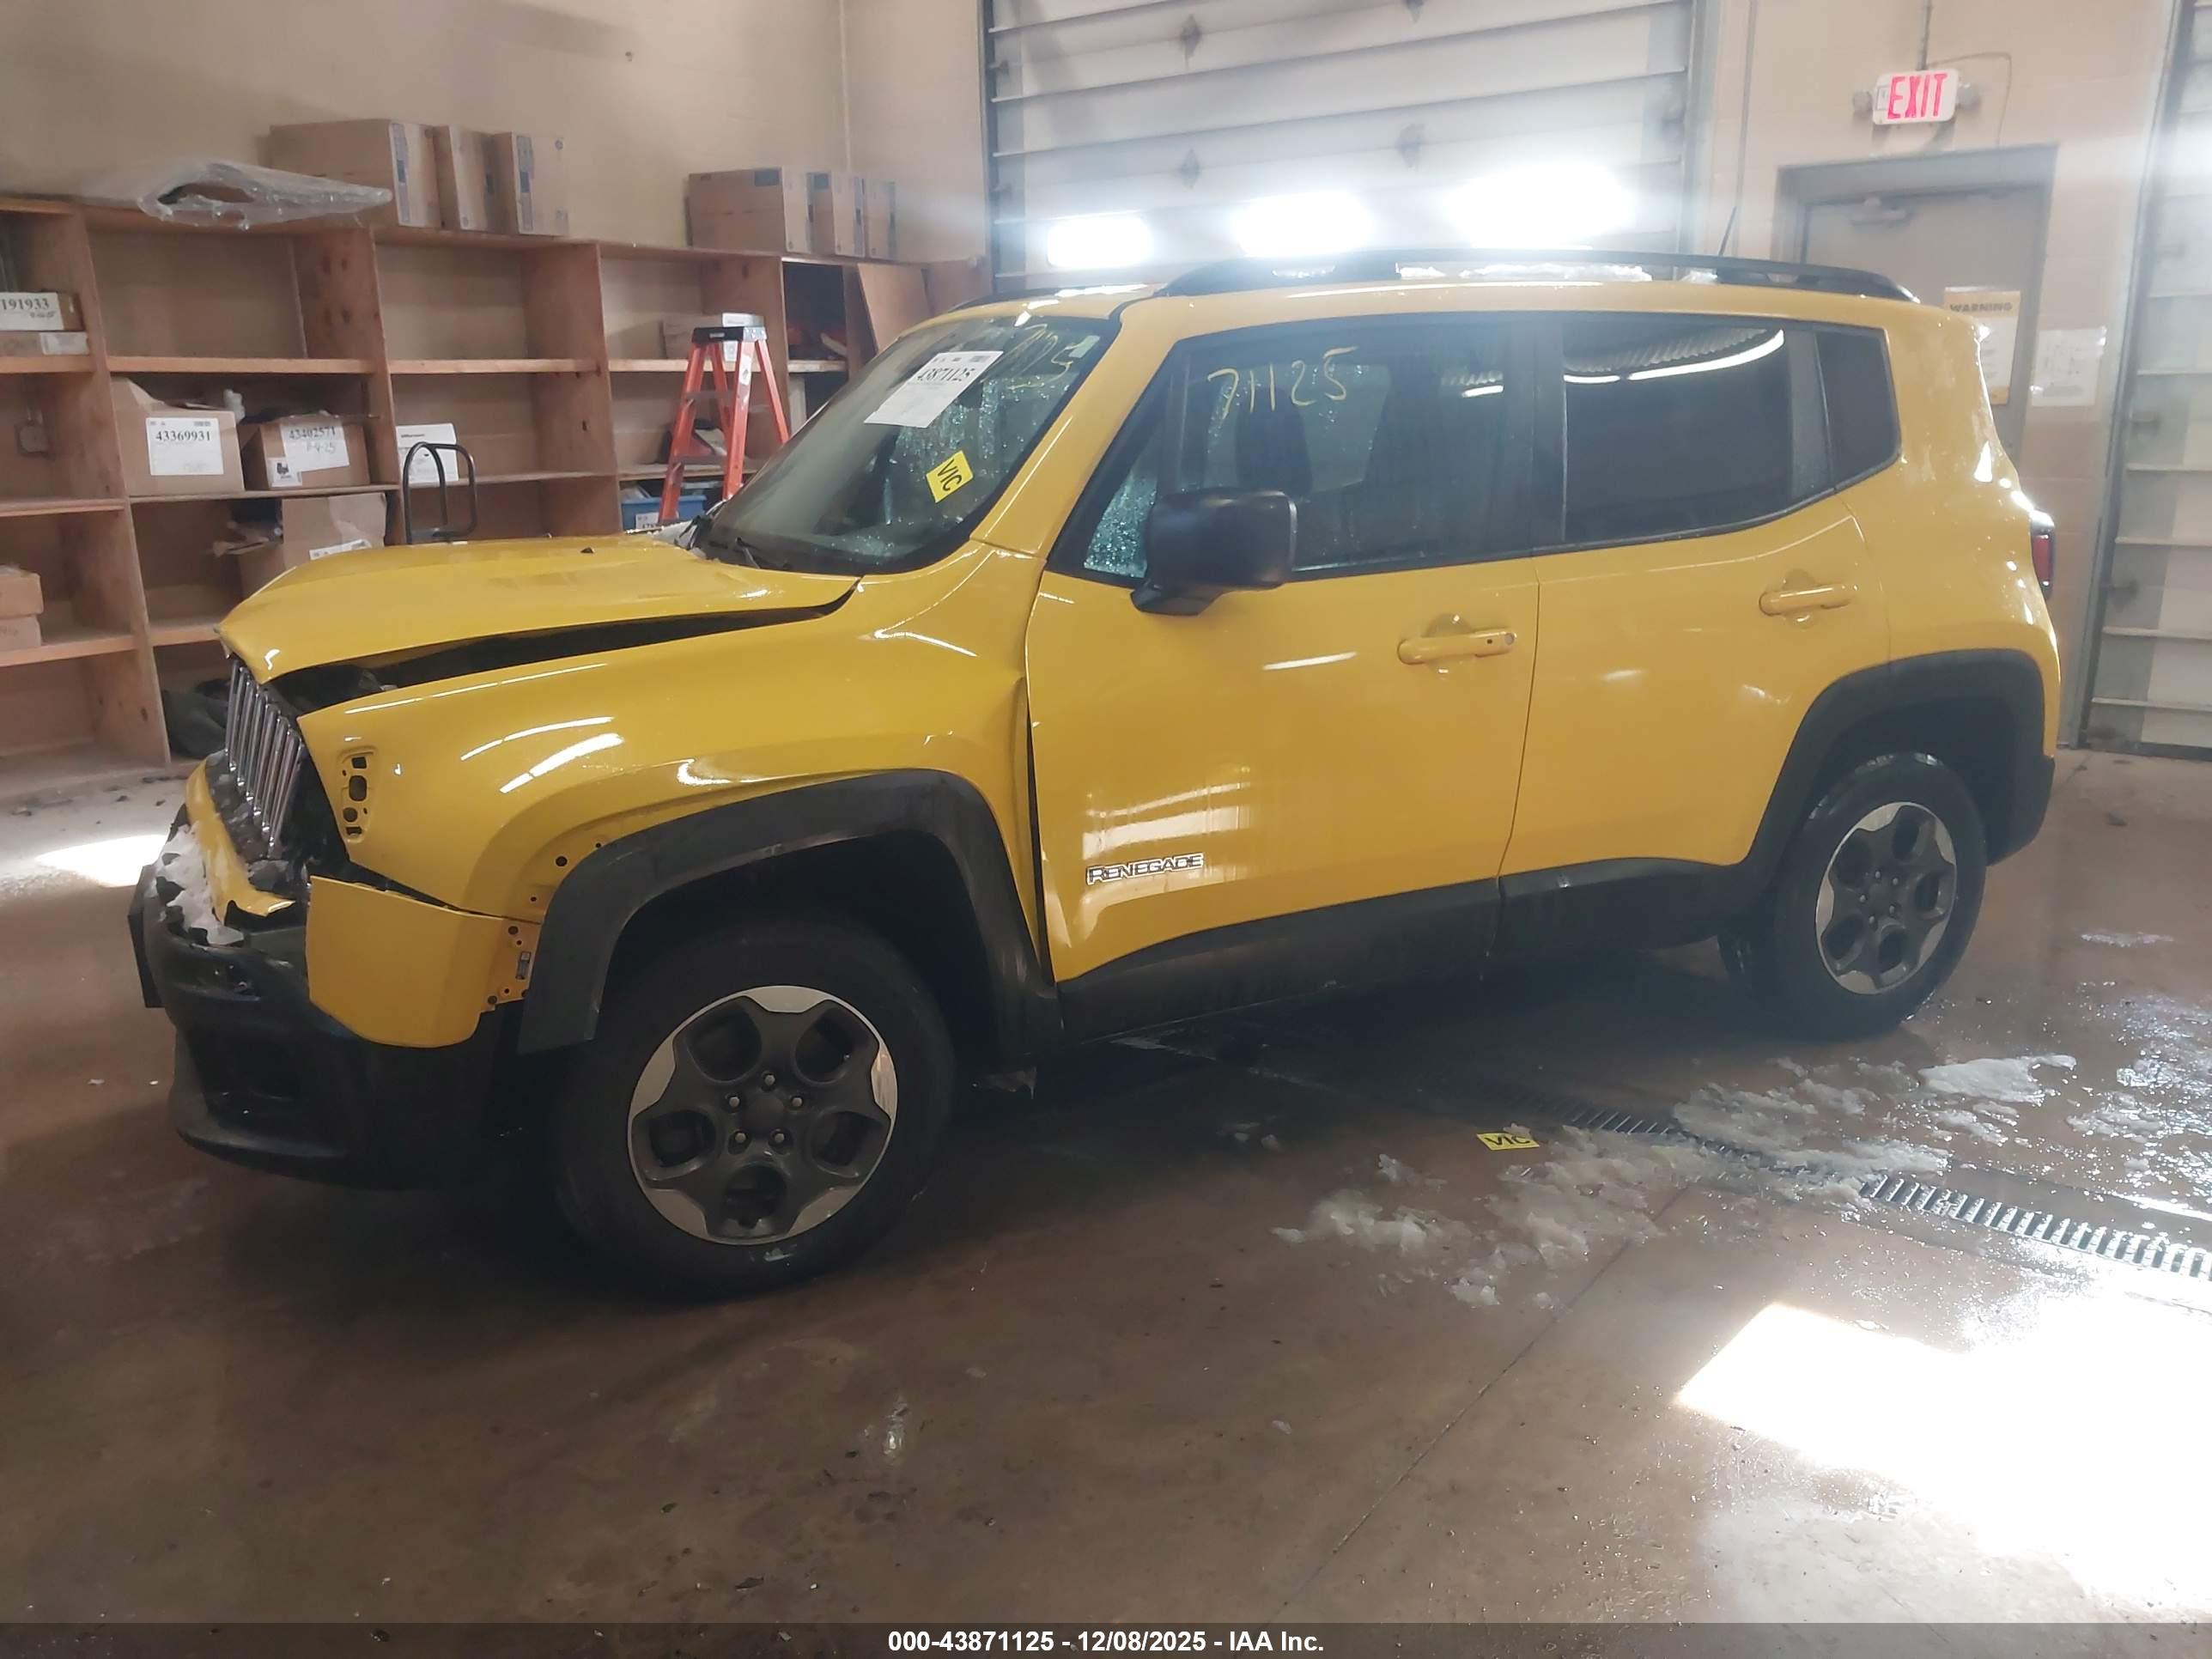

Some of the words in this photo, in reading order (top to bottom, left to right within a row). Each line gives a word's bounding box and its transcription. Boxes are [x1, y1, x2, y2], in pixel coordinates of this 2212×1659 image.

[1887, 72, 1948, 119] EXIT
[1950, 302, 2012, 312] WARNING
[1207, 346, 1359, 419] 71125
[155, 430, 210, 441] 43369931
[937, 459, 963, 492] VIC
[1086, 853, 1204, 885] RENEGADE
[1483, 1134, 1530, 1146] VIC
